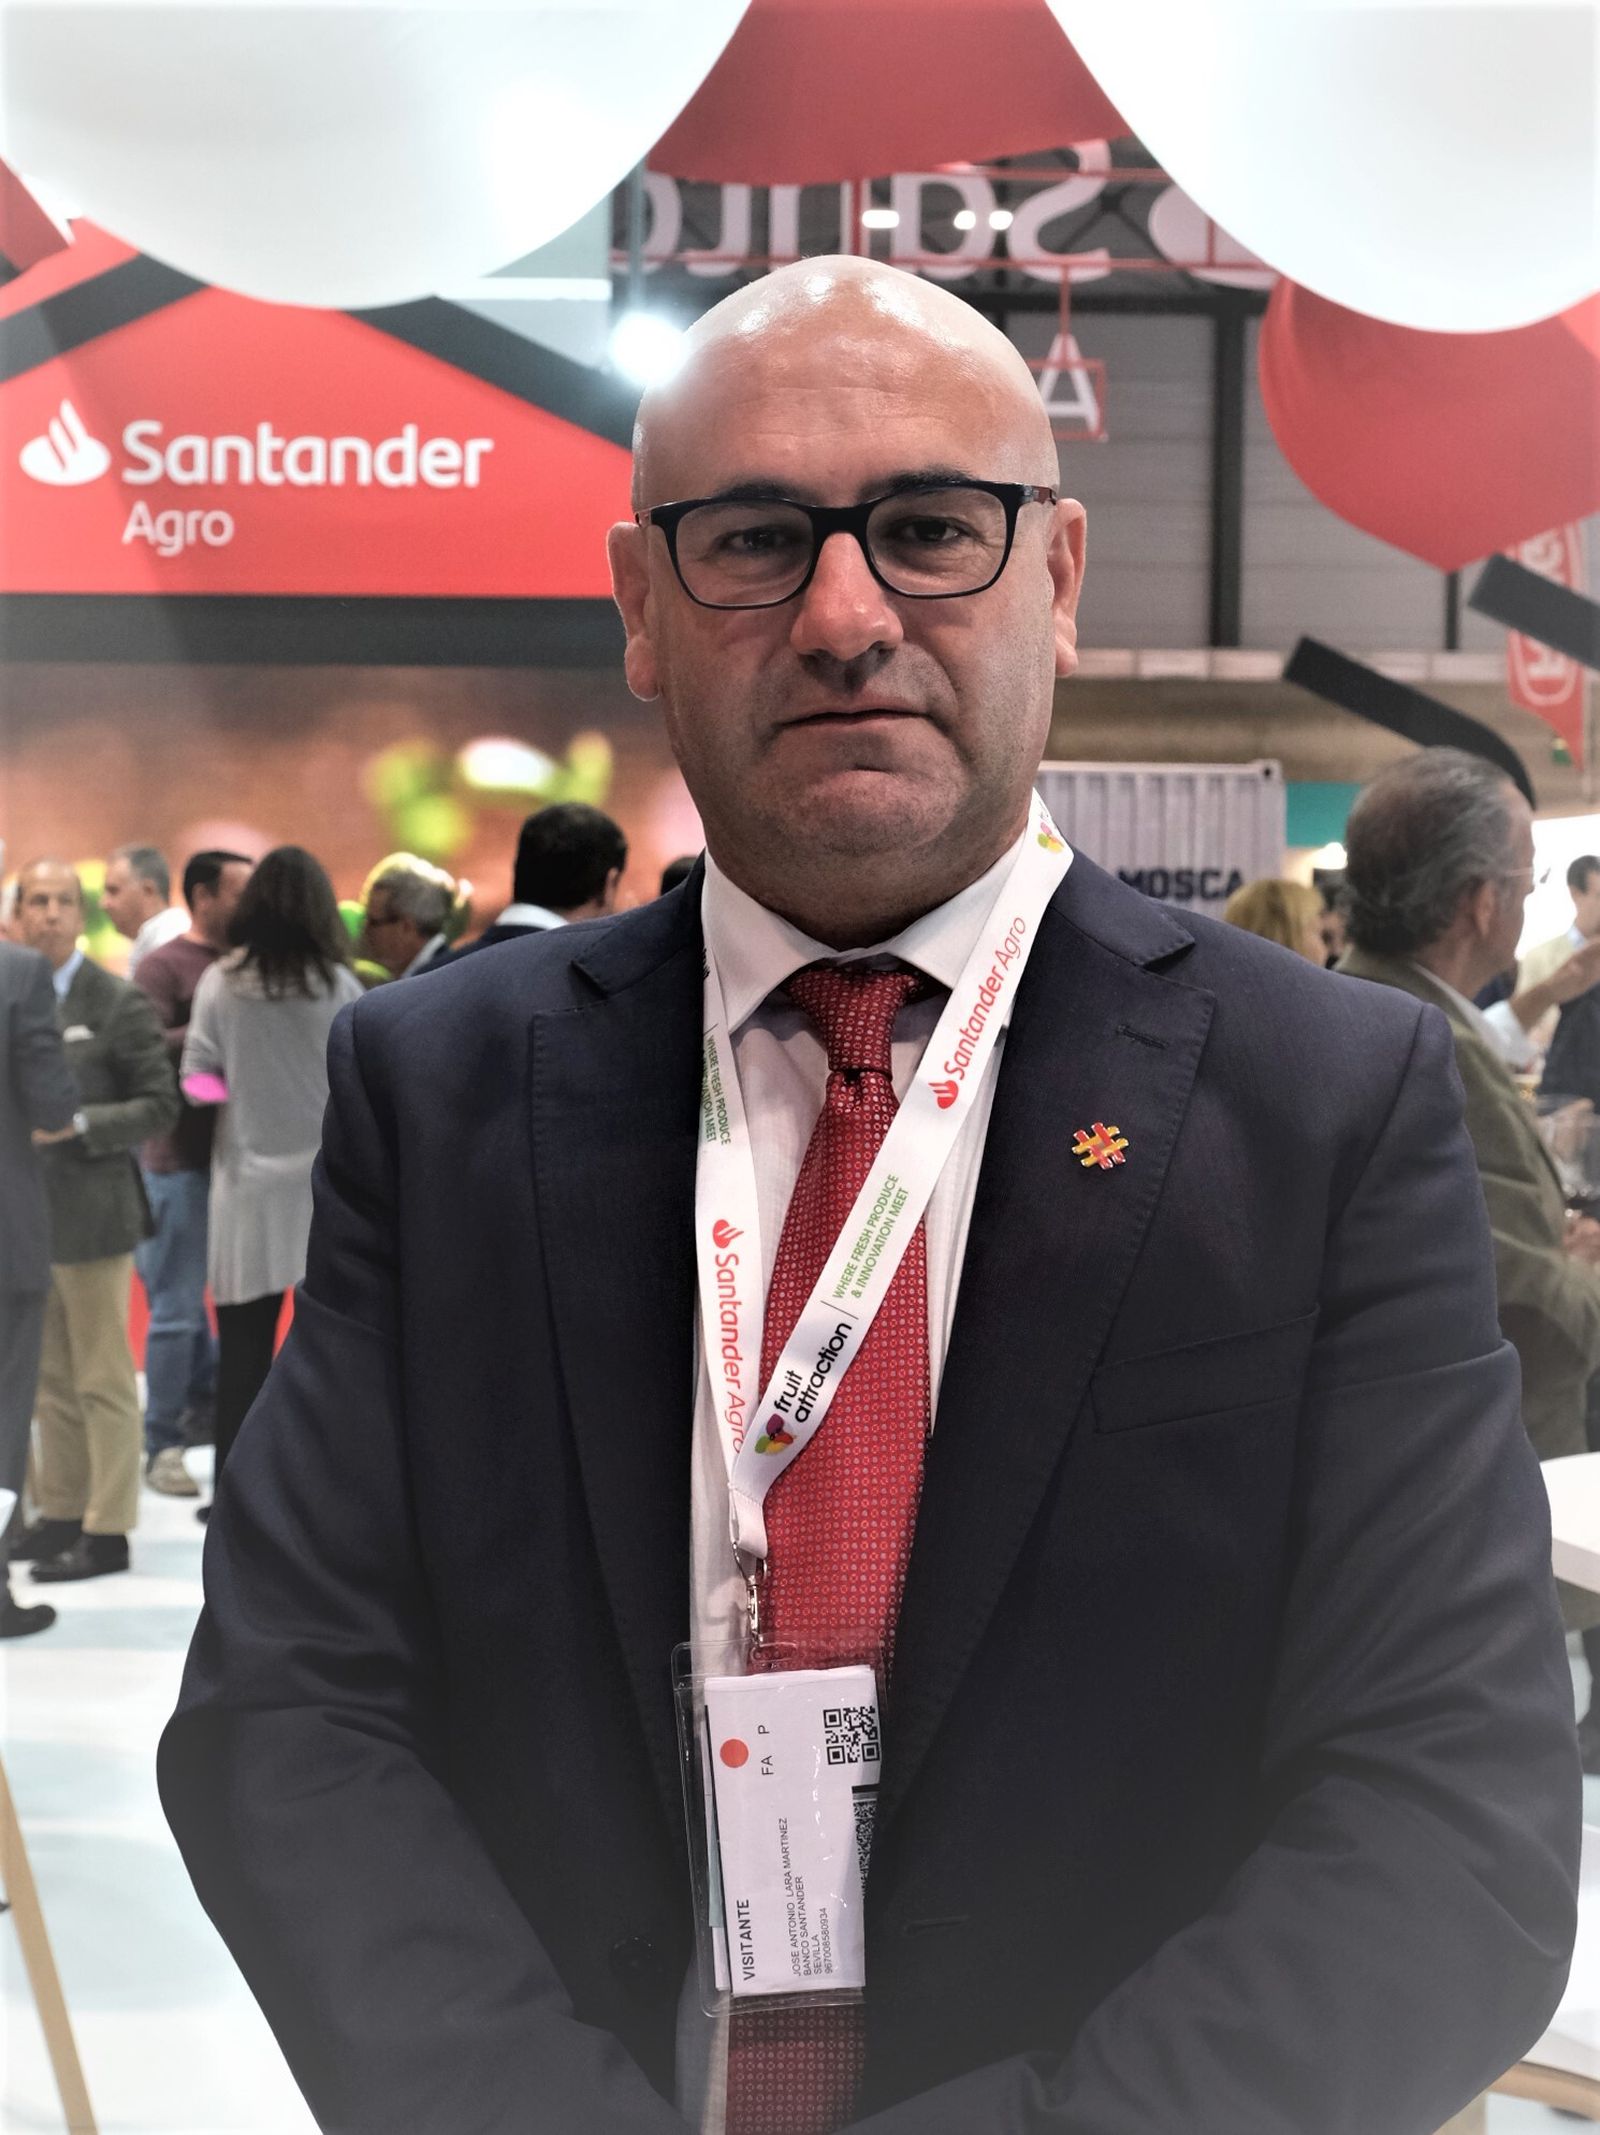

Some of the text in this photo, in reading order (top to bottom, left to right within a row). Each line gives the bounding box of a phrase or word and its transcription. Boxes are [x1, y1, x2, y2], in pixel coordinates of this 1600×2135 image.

[121, 419, 495, 487] Santander
[121, 499, 234, 557] Agro
[943, 916, 1026, 1081] Santander Agro
[704, 1117, 717, 1143] MEET
[707, 1034, 732, 1146] WHERE FRESH PRODUCE
[832, 1173, 899, 1299] WHERE FRESH PRODUCE
[850, 1187, 909, 1299] & INNOVATION MEET
[714, 1253, 746, 1454] Santander Agro
[773, 1369, 803, 1414] fruit
[794, 1322, 853, 1424] attraction
[757, 1724, 774, 1776] FA P
[736, 1898, 755, 1982] VISITANTE
[779, 1817, 802, 1977] JOSE ANTONIO LARA MARTINEZ
[795, 1876, 812, 1977] BANCO SANTANDER
[811, 1934, 823, 1975] SEVILLA
